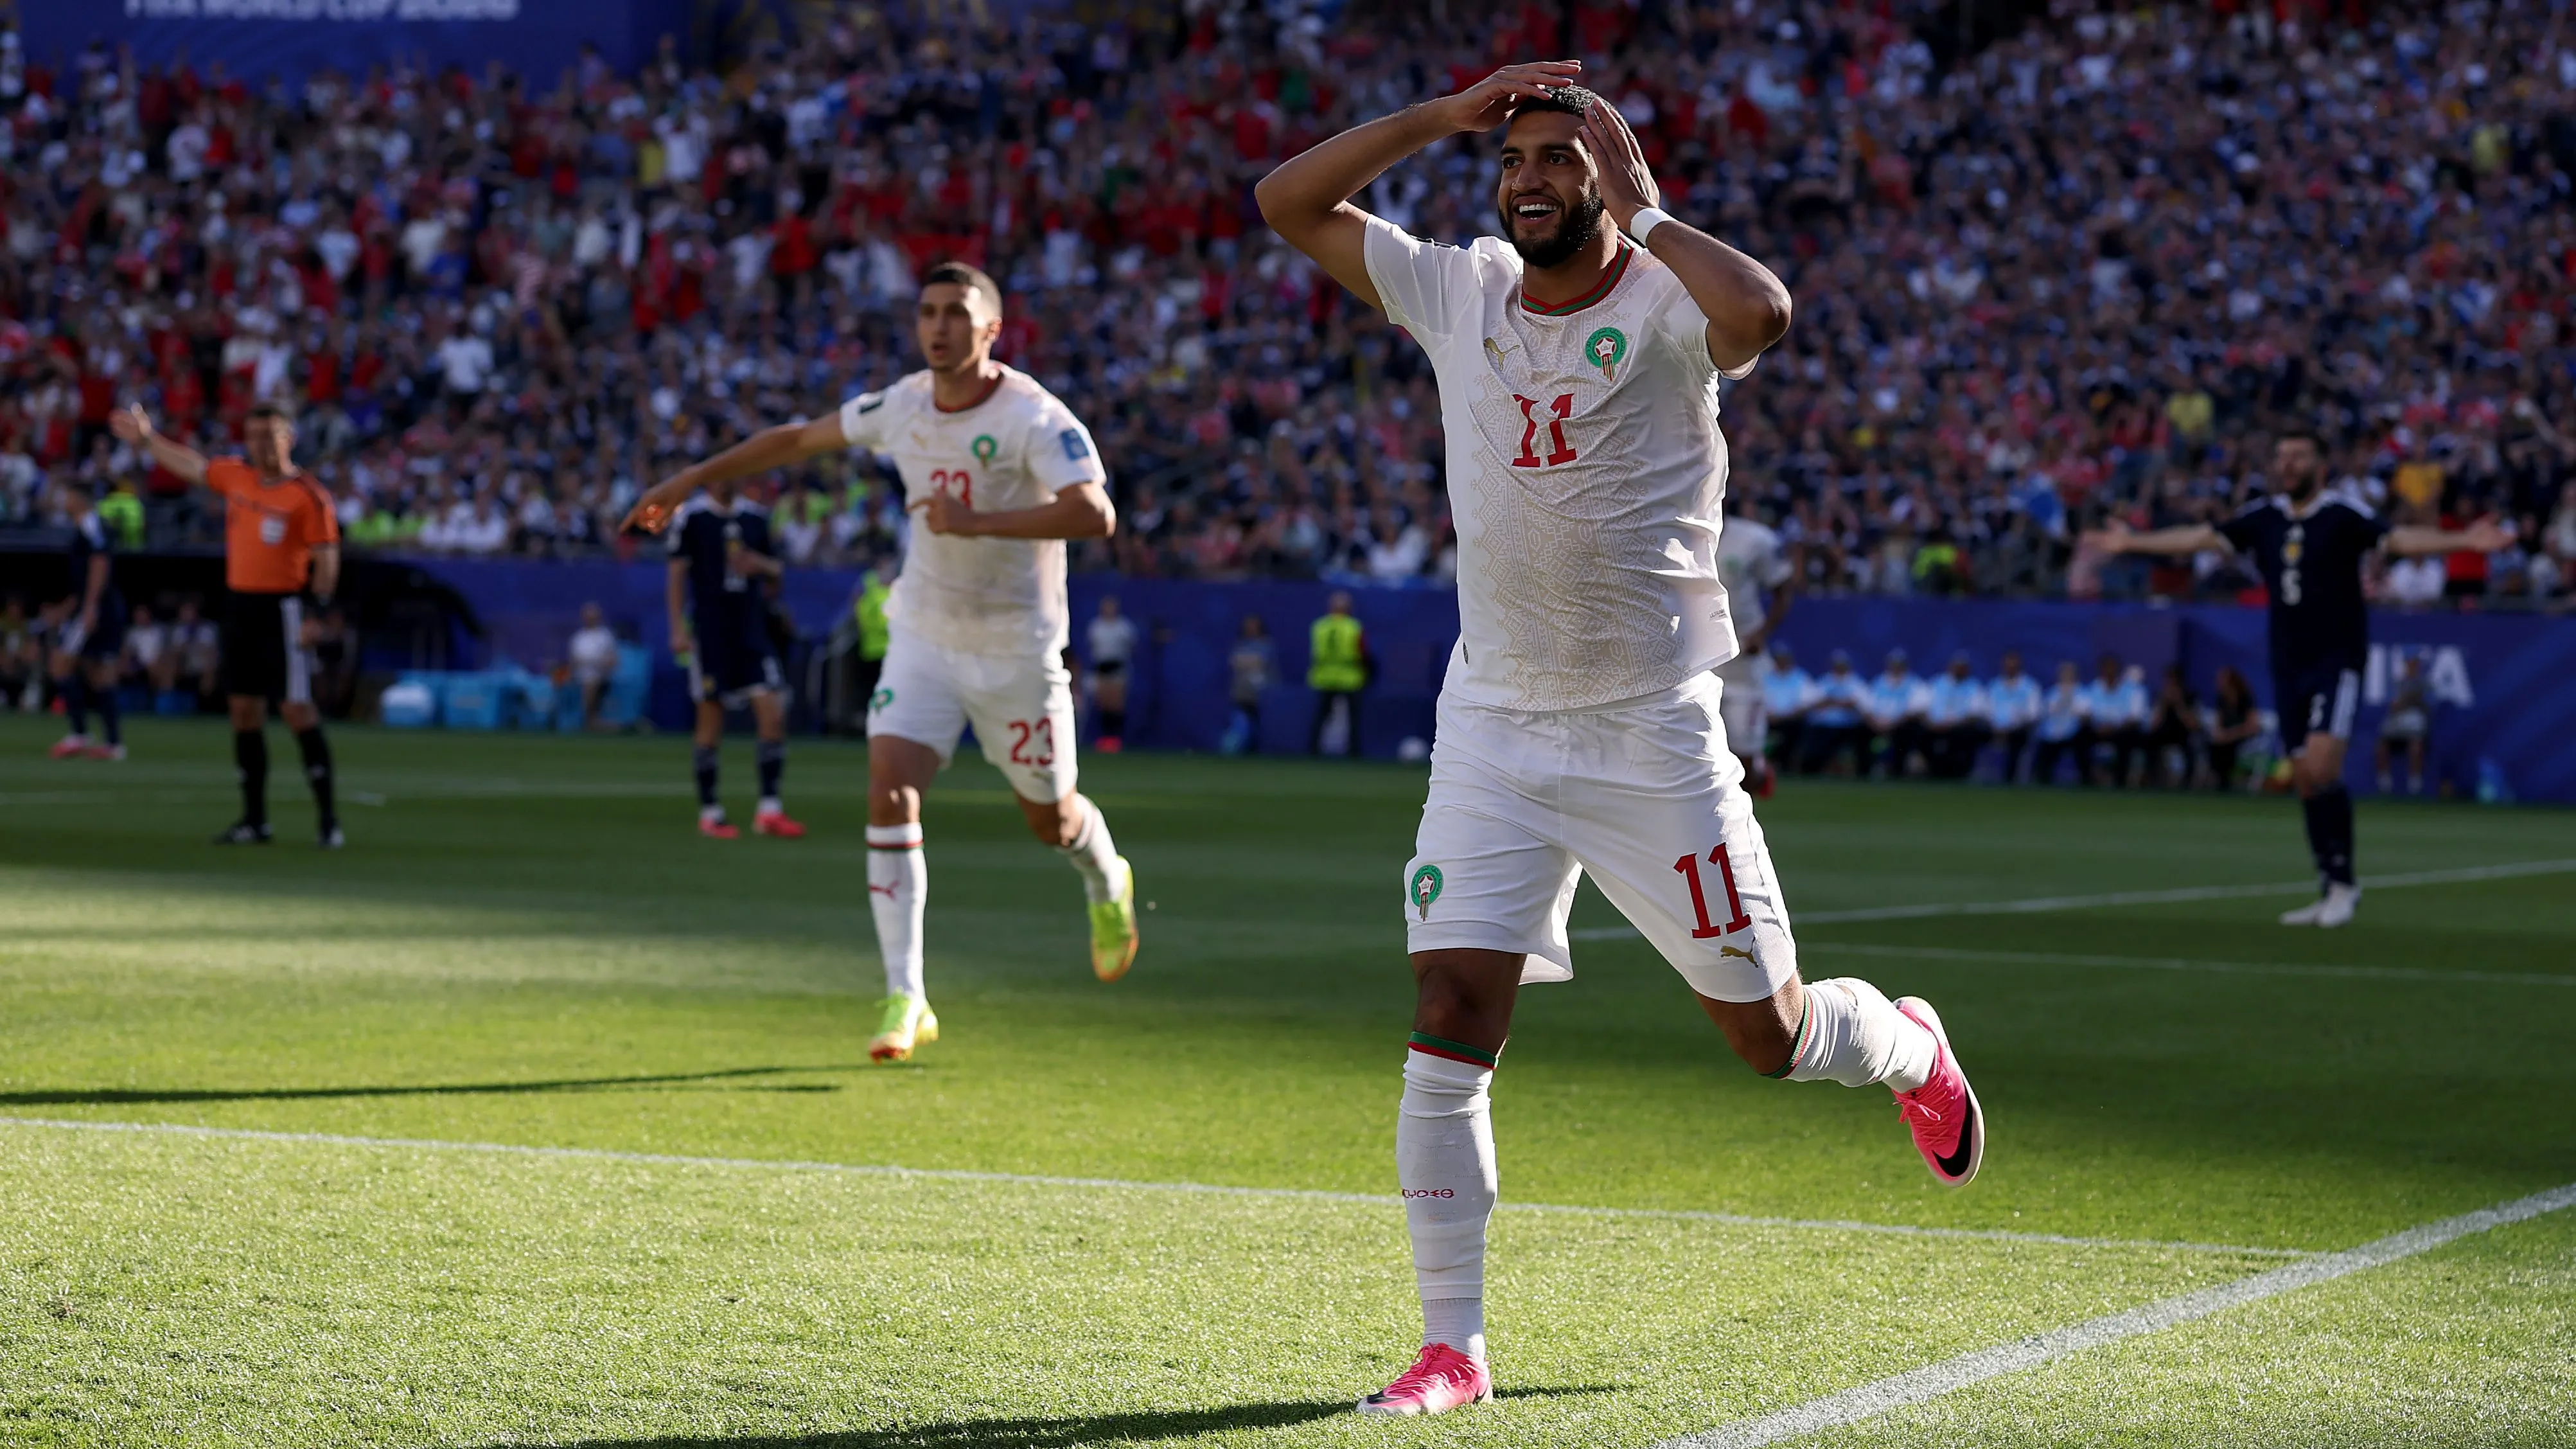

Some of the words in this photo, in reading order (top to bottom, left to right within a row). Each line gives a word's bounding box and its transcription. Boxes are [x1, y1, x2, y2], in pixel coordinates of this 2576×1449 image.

[1512, 393, 1577, 467] 11
[1008, 716, 1055, 766] 23
[1673, 842, 1752, 939] 11
